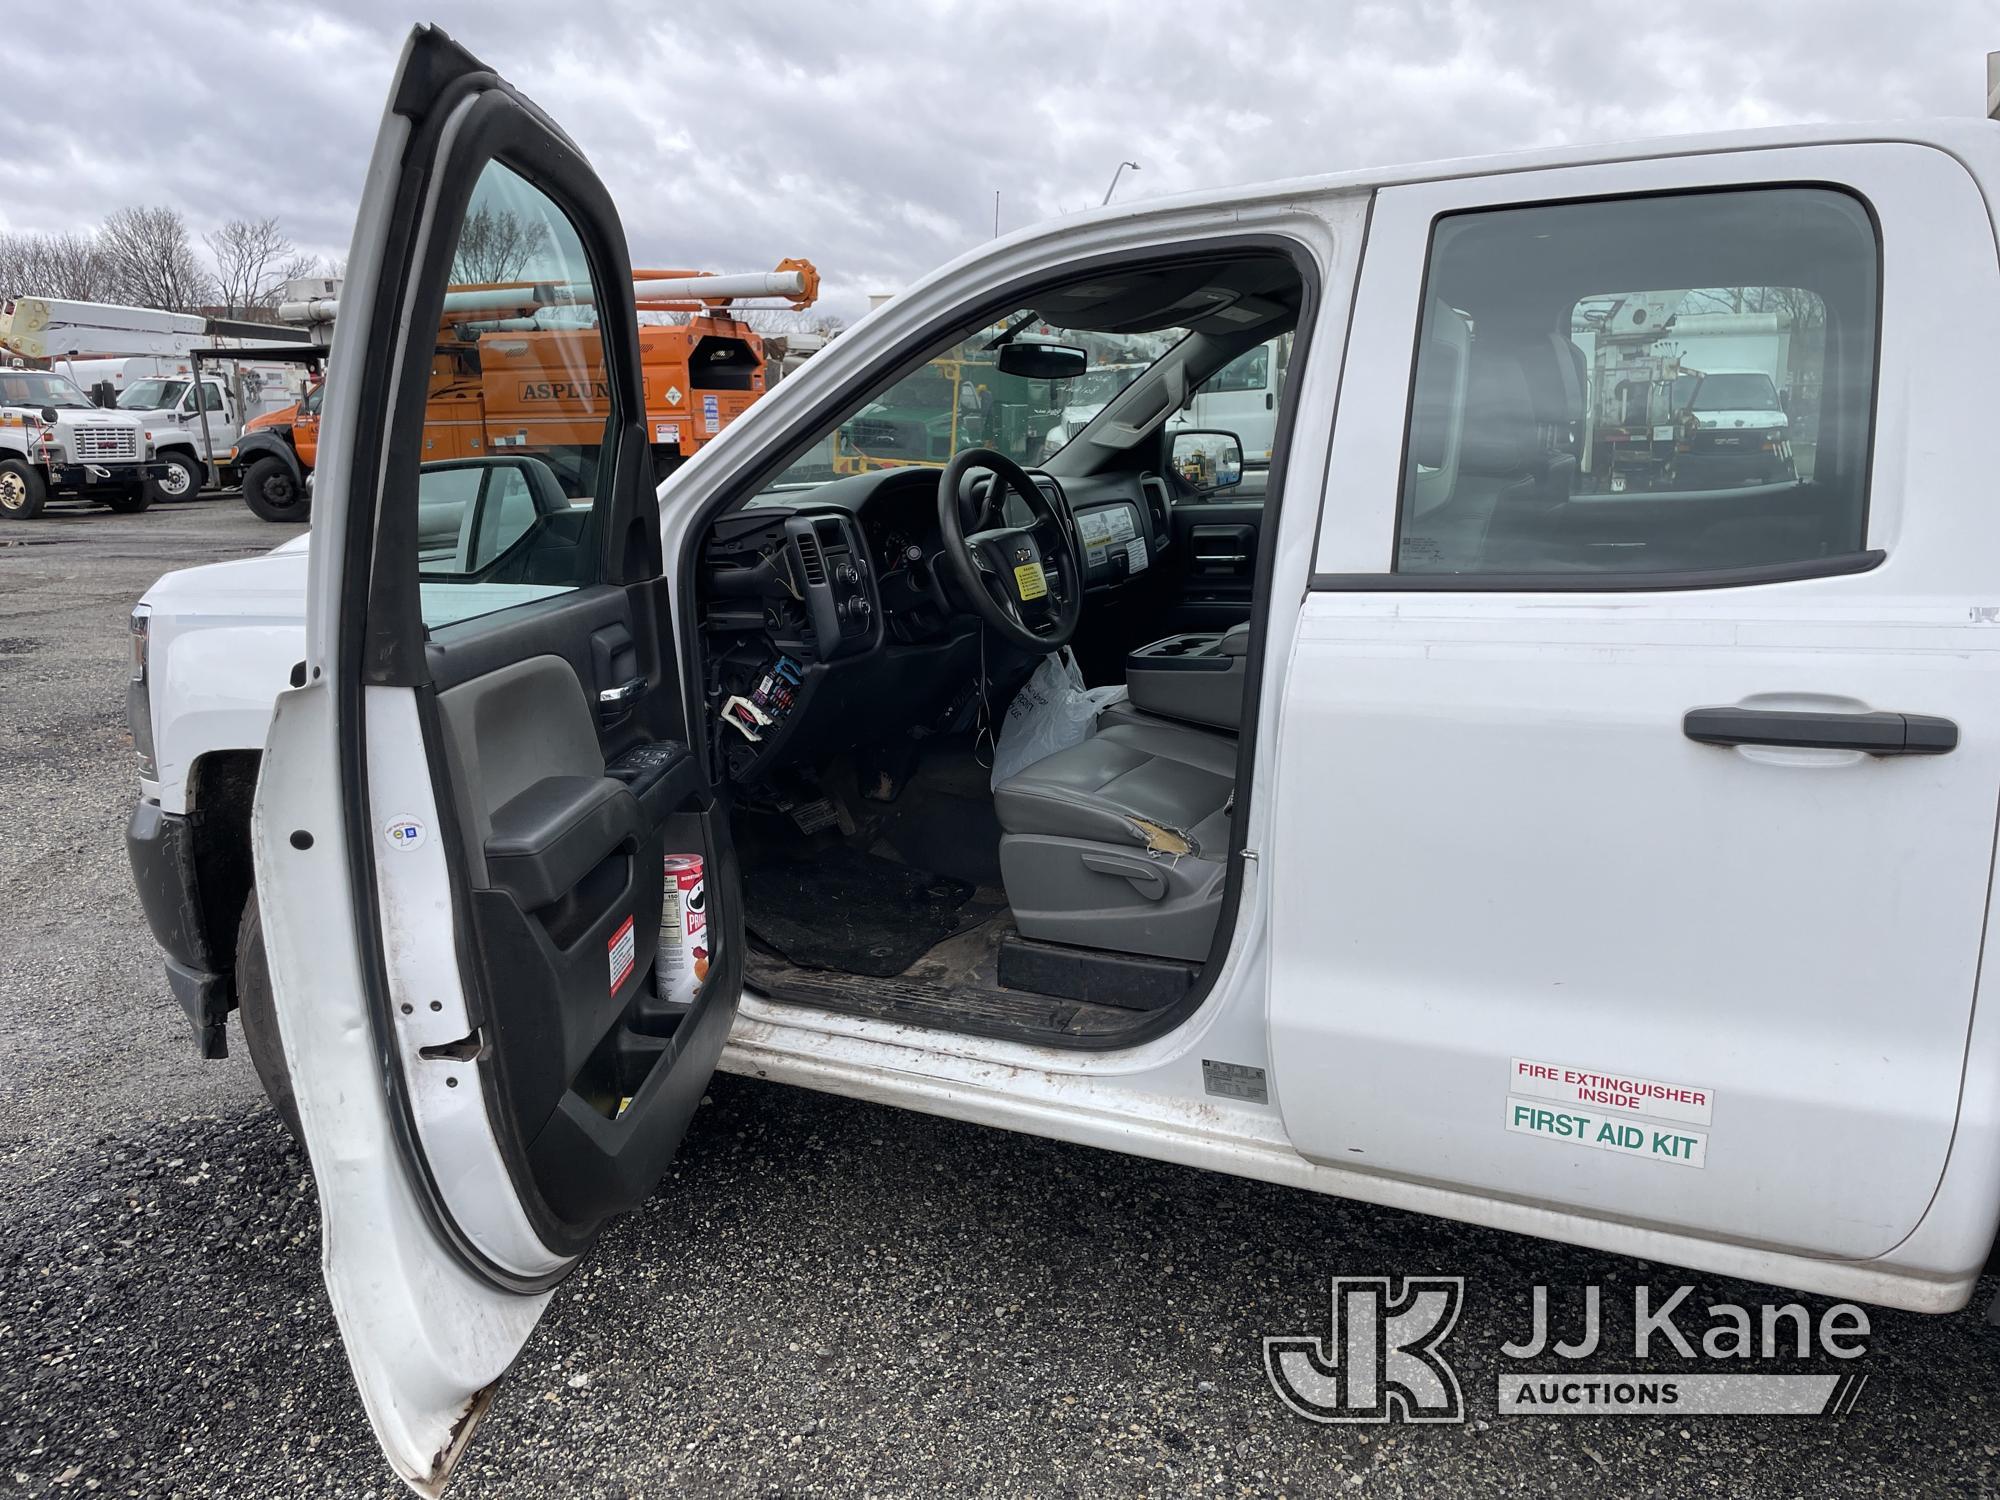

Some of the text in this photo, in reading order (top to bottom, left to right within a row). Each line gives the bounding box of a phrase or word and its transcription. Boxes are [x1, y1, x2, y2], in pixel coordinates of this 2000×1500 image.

[523, 383, 611, 400] ASPLUN
[1518, 1063, 1706, 1106] FIRE EXTINGUISHER
[1578, 1088, 1640, 1109] INSIDE
[1514, 1106, 1698, 1160] FIRST AID KIT
